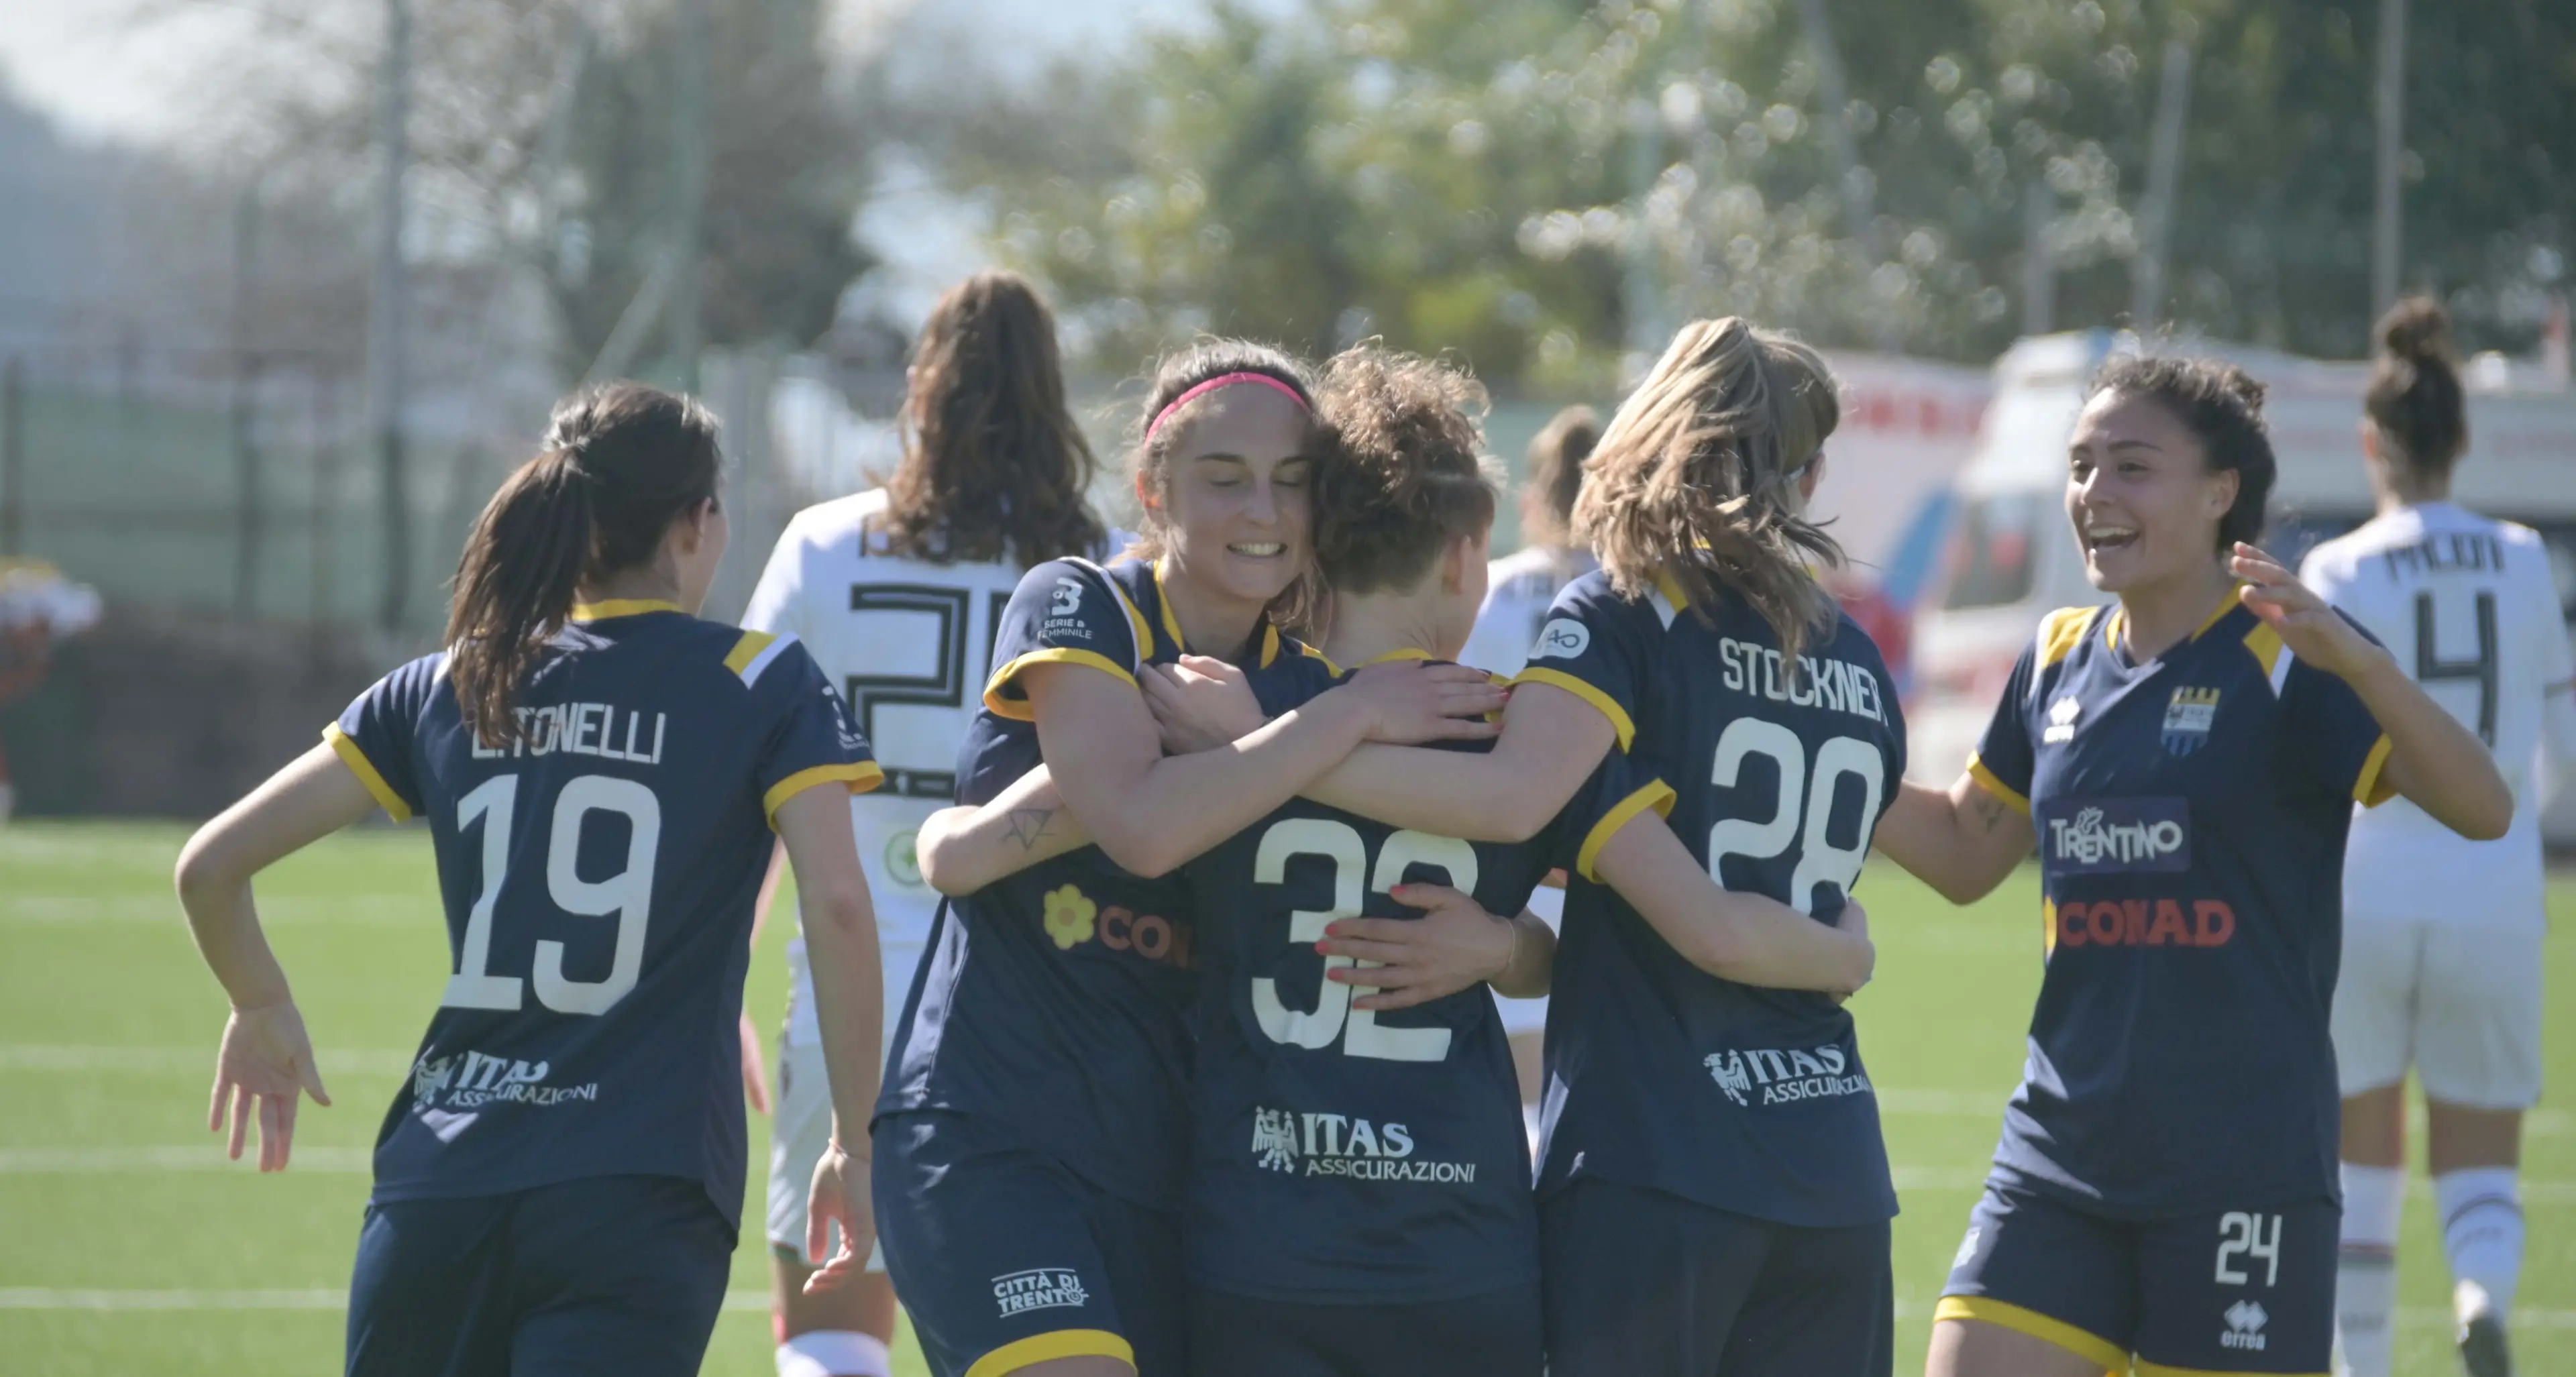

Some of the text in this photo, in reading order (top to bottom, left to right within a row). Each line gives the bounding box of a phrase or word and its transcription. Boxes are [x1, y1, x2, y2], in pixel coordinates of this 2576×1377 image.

[1044, 618, 1085, 629] SERIE B
[2416, 593, 2498, 750] 4
[2049, 818, 2184, 863] TRENTINO
[439, 773, 661, 1016] 19
[1251, 818, 1479, 1062] 32
[2058, 899, 2236, 948] CONAD
[1743, 1044, 1845, 1084] ITAS
[445, 1082, 599, 1107] ASSURAZIONI
[1301, 1112, 1414, 1157] ITAS
[1305, 1158, 1475, 1183] ASSICURAZIONI
[2215, 1211, 2283, 1287] 24
[997, 1286, 1085, 1313] TRENTO
[1058, 1273, 1080, 1290] DI
